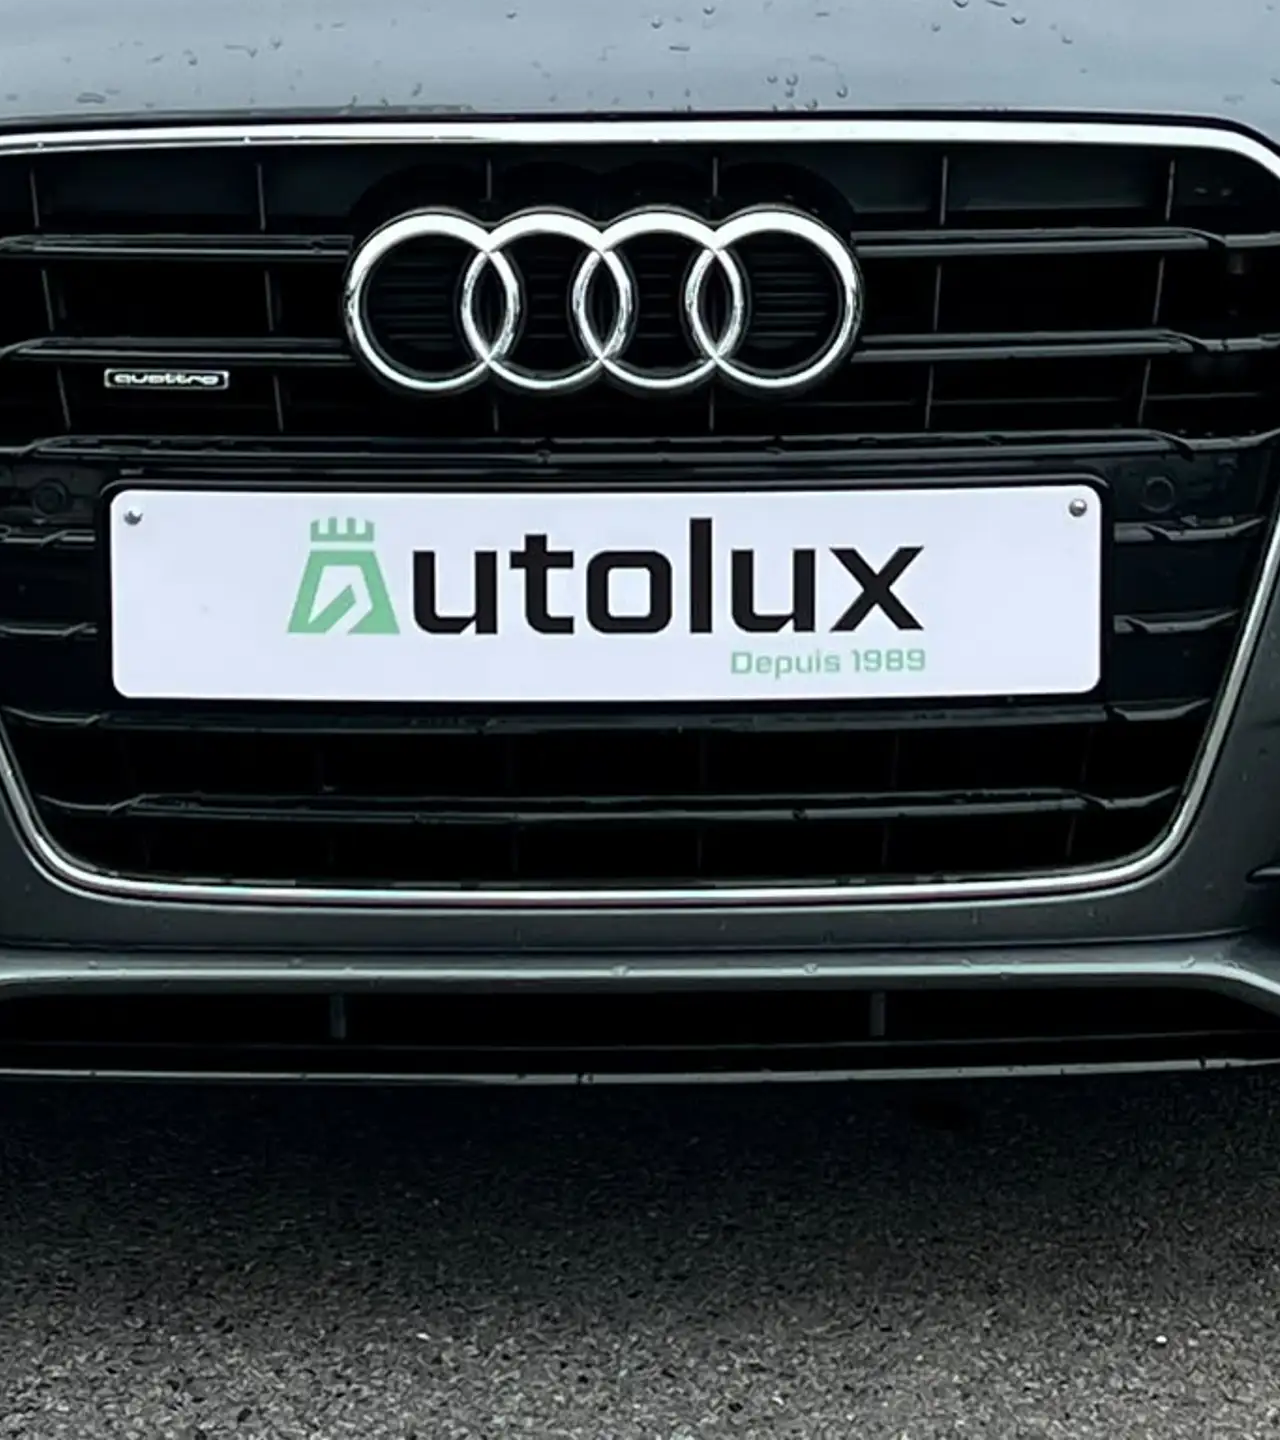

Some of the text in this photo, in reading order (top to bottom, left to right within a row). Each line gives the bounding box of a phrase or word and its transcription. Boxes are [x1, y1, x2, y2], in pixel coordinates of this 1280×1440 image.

[113, 372, 220, 386] quattro
[730, 648, 926, 678] Depuis 1989
